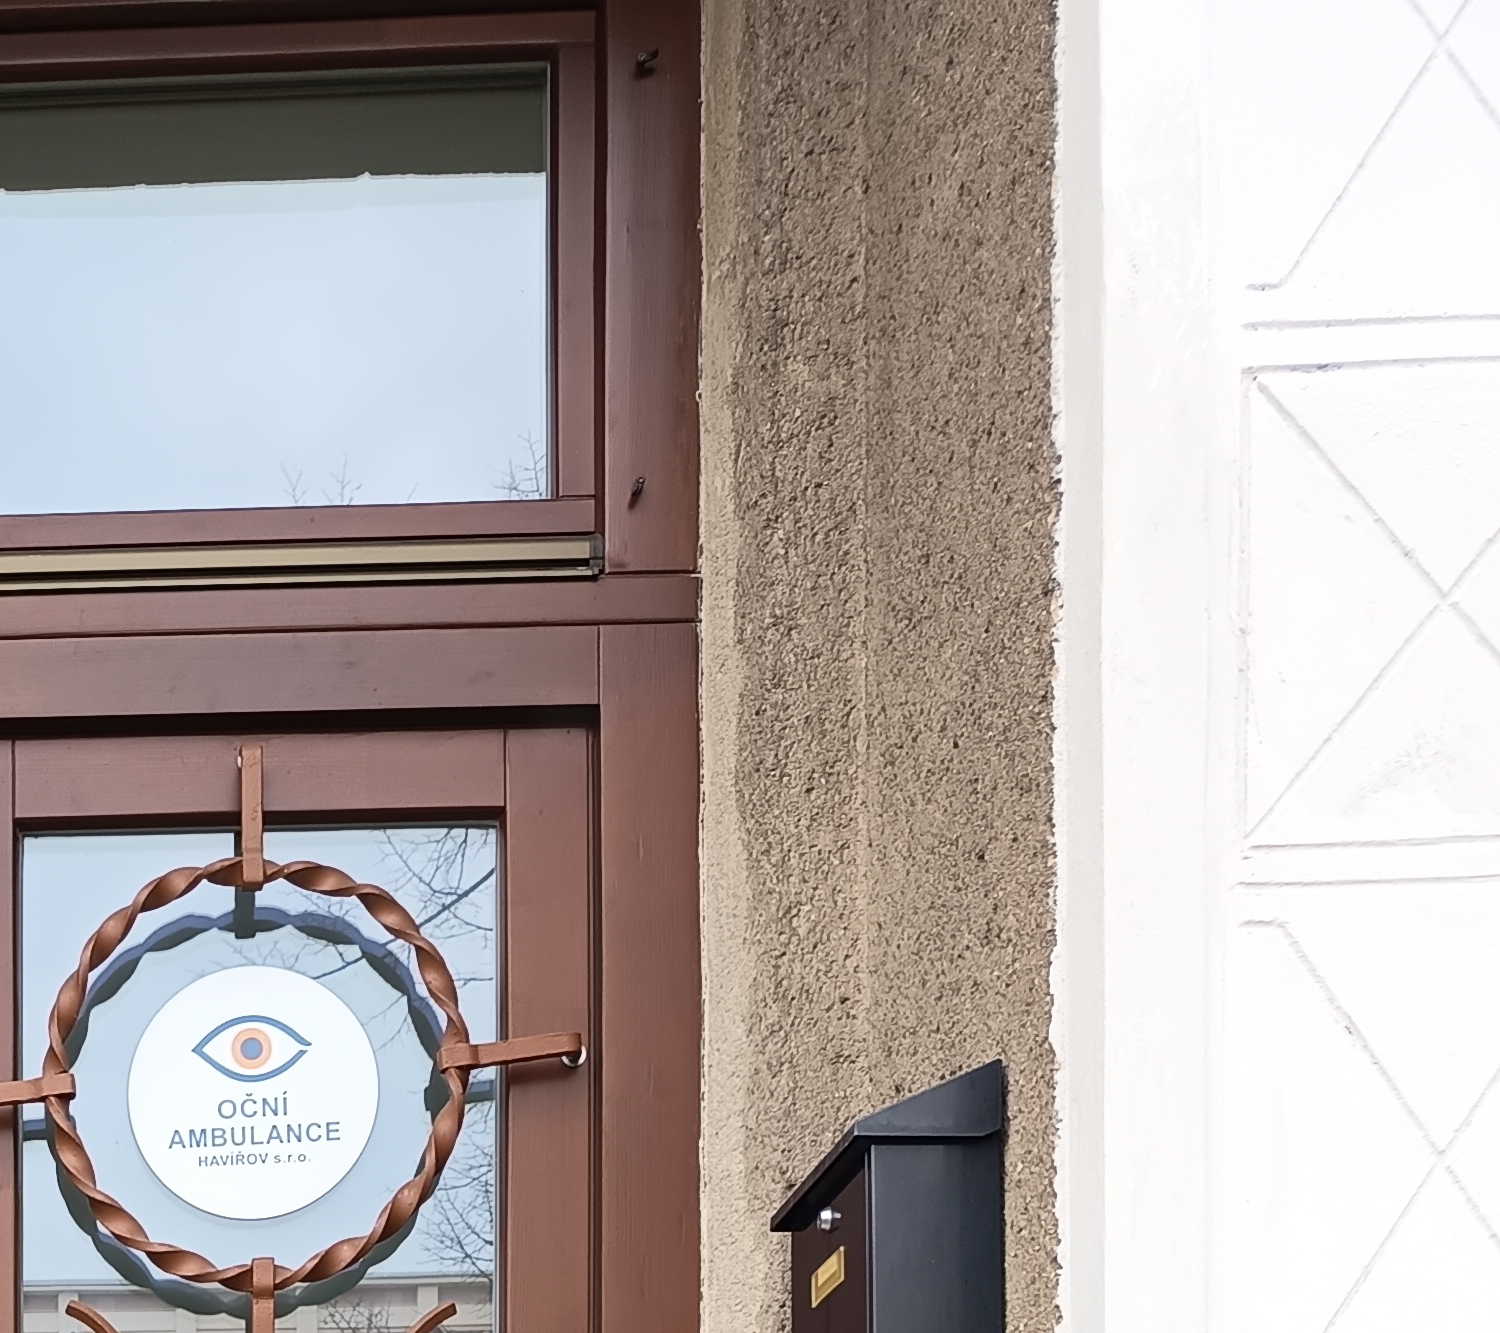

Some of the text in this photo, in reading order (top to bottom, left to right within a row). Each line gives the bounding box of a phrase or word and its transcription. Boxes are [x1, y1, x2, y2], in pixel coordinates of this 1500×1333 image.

[217, 1090, 288, 1119] OČNÍ
[168, 1121, 341, 1149] AMBULANCE
[198, 1151, 311, 1167] HAVÍŘOV s.r.o.
